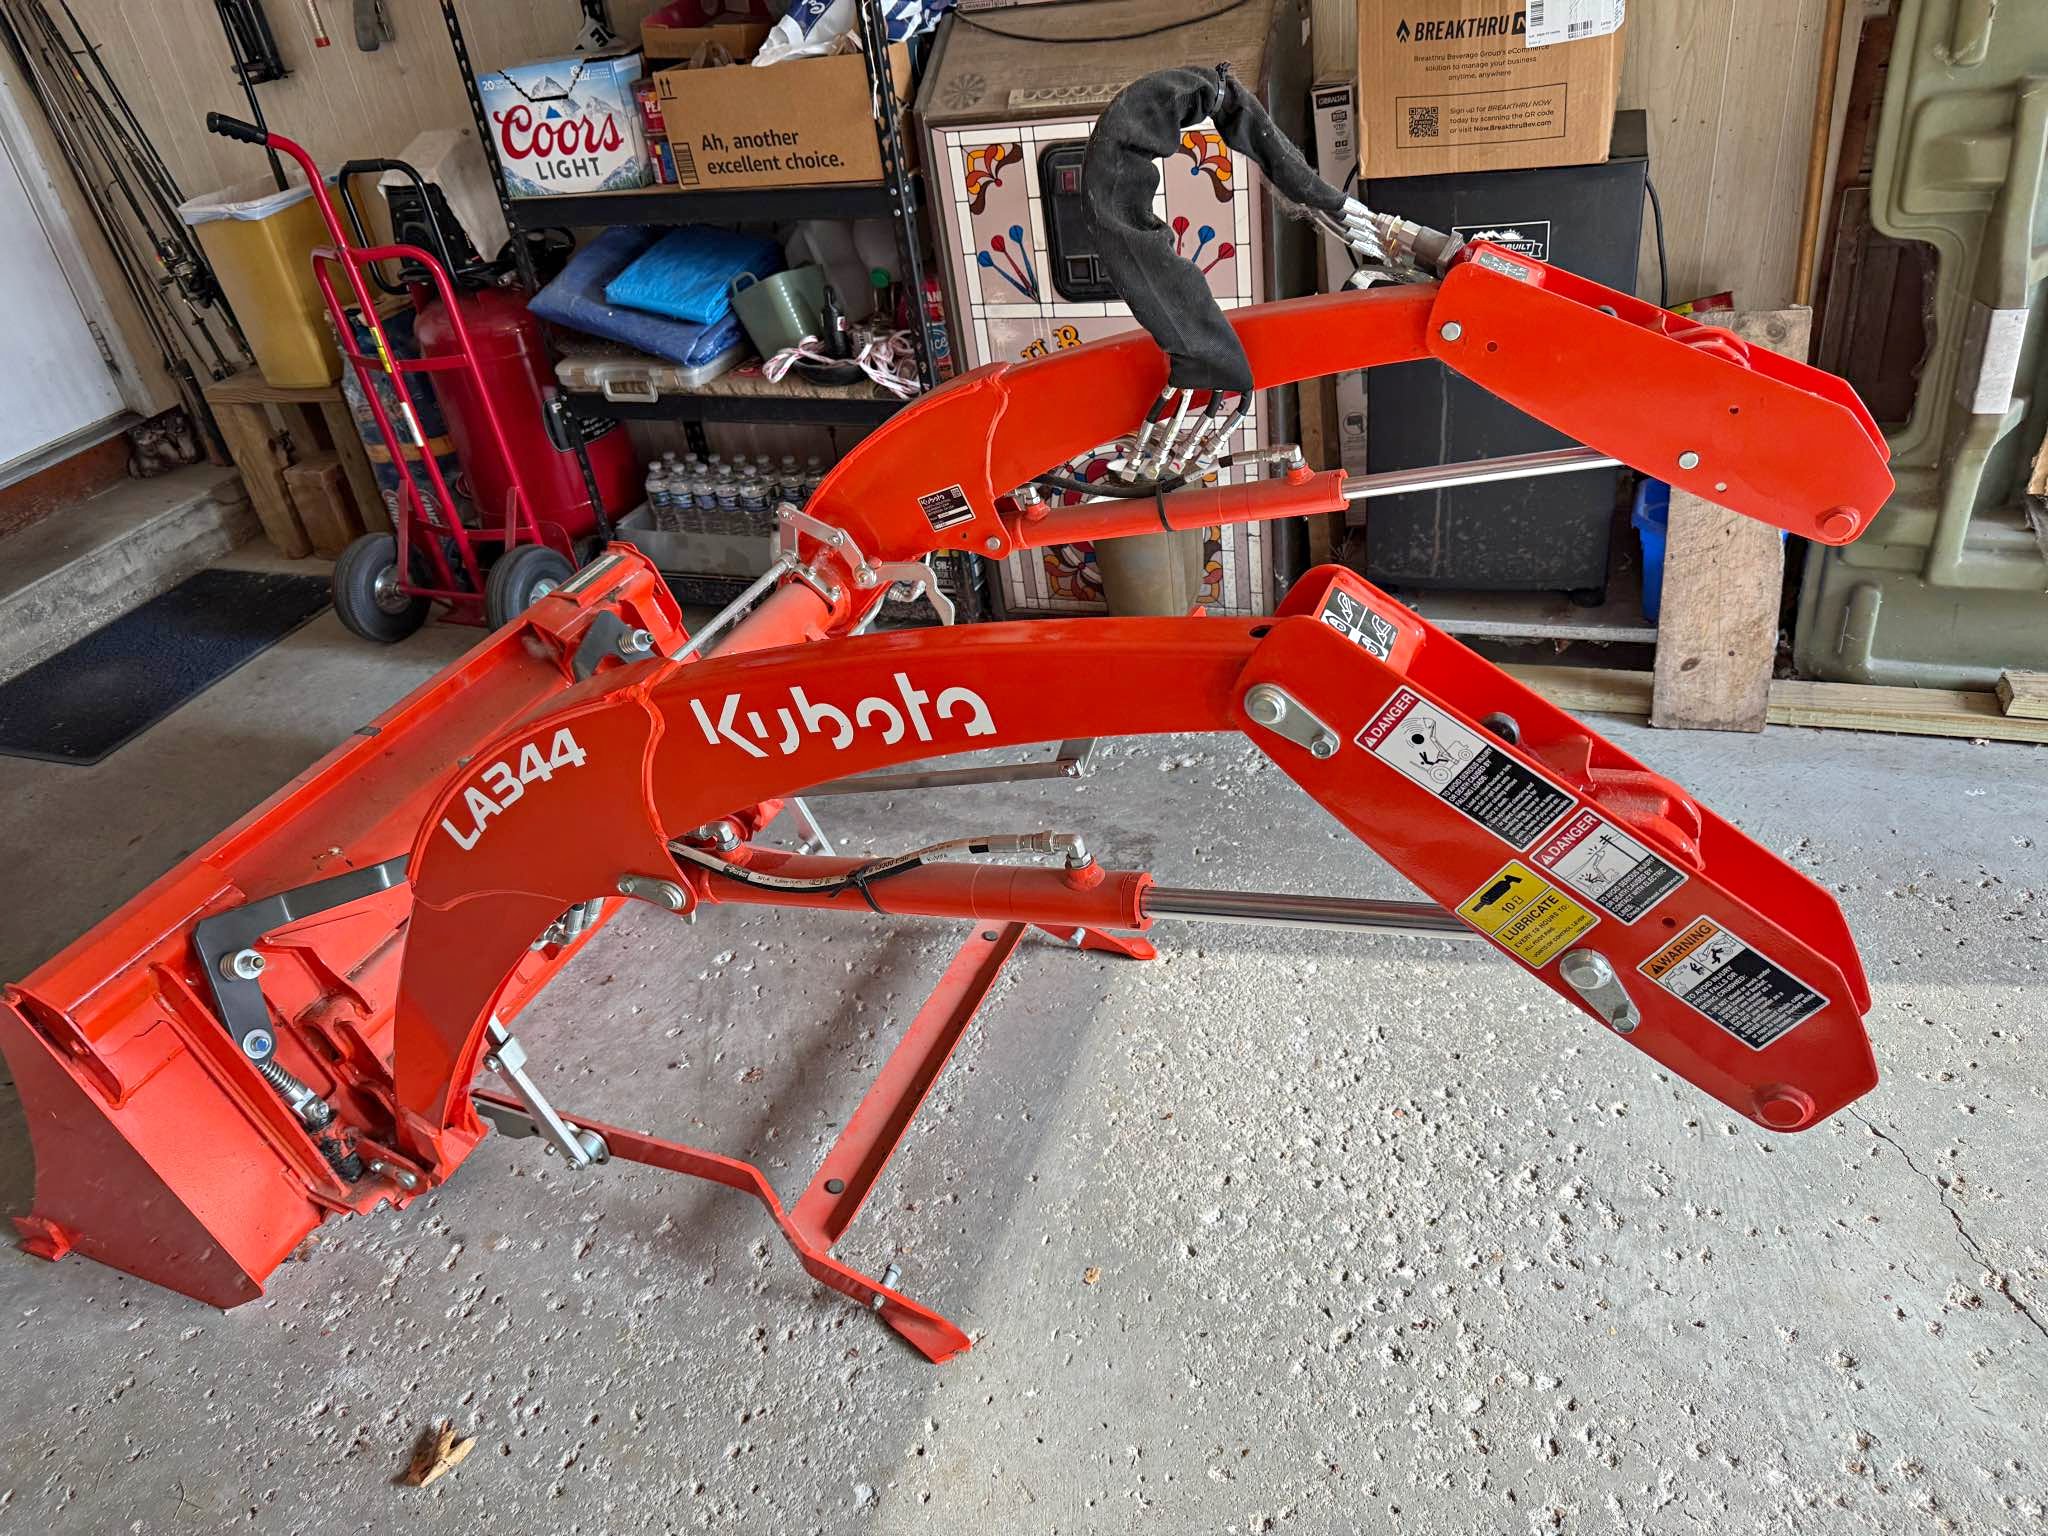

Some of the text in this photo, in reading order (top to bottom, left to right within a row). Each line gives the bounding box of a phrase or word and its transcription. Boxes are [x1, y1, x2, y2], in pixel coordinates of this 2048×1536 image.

[1414, 14, 1510, 41] BREAKTHRU
[1414, 44, 1550, 62] Breakthru Beverage Group's eCommerce
[1425, 64, 1451, 72] solution
[1462, 62, 1489, 71] manage
[1490, 60, 1505, 69] your
[1508, 56, 1537, 65] business
[482, 80, 495, 91] 20
[1448, 69, 1512, 81] anytime, anywhere
[1450, 98, 1552, 115] Sign up for BREAKTHRU NOW
[1450, 117, 1469, 125] today
[1480, 113, 1511, 122] scanning
[1537, 109, 1554, 117] code
[493, 104, 624, 160] Coors
[702, 129, 800, 153] Ah, another
[1473, 119, 1552, 132] Now.BreakthruBev.com
[535, 157, 600, 181] LIGHT
[707, 151, 845, 175] excellent choice.
[920, 494, 945, 506] Kubota
[690, 672, 997, 758] Kubota
[1370, 693, 1415, 739] DANGER
[441, 728, 587, 850] LA344
[1441, 789, 1451, 798] TO
[1447, 778, 1462, 792] AVOID
[1459, 761, 1479, 780] SERIOUS
[1475, 747, 1492, 763] INJURY
[1448, 758, 1492, 802] OR DEATH CAUSED BY
[1454, 788, 1473, 806] FALLING
[1470, 773, 1488, 790] LOADS:
[1548, 815, 1597, 857] DANGER
[1604, 885, 1621, 898] AVOID
[1617, 869, 1640, 887] SERIOUS
[1635, 856, 1656, 871] INJURY
[1610, 867, 1667, 912] CONTACT WITH ELECTRIC
[1611, 888, 1629, 901] DEATH
[1625, 873, 1647, 890] CAUSED
[1500, 901, 1516, 913] 10
[1501, 895, 1559, 940] LUBRICATE
[1514, 933, 1533, 947] EVERY
[1538, 911, 1559, 928] HOURS
[1558, 903, 1570, 912] TO:
[1660, 925, 1712, 966] WARNING
[1685, 965, 1733, 1001] TO AVOID INJURY
[1692, 971, 1738, 1005] FROM FALLS OR
[1698, 973, 1748, 1010] BEING CRUSHED:
